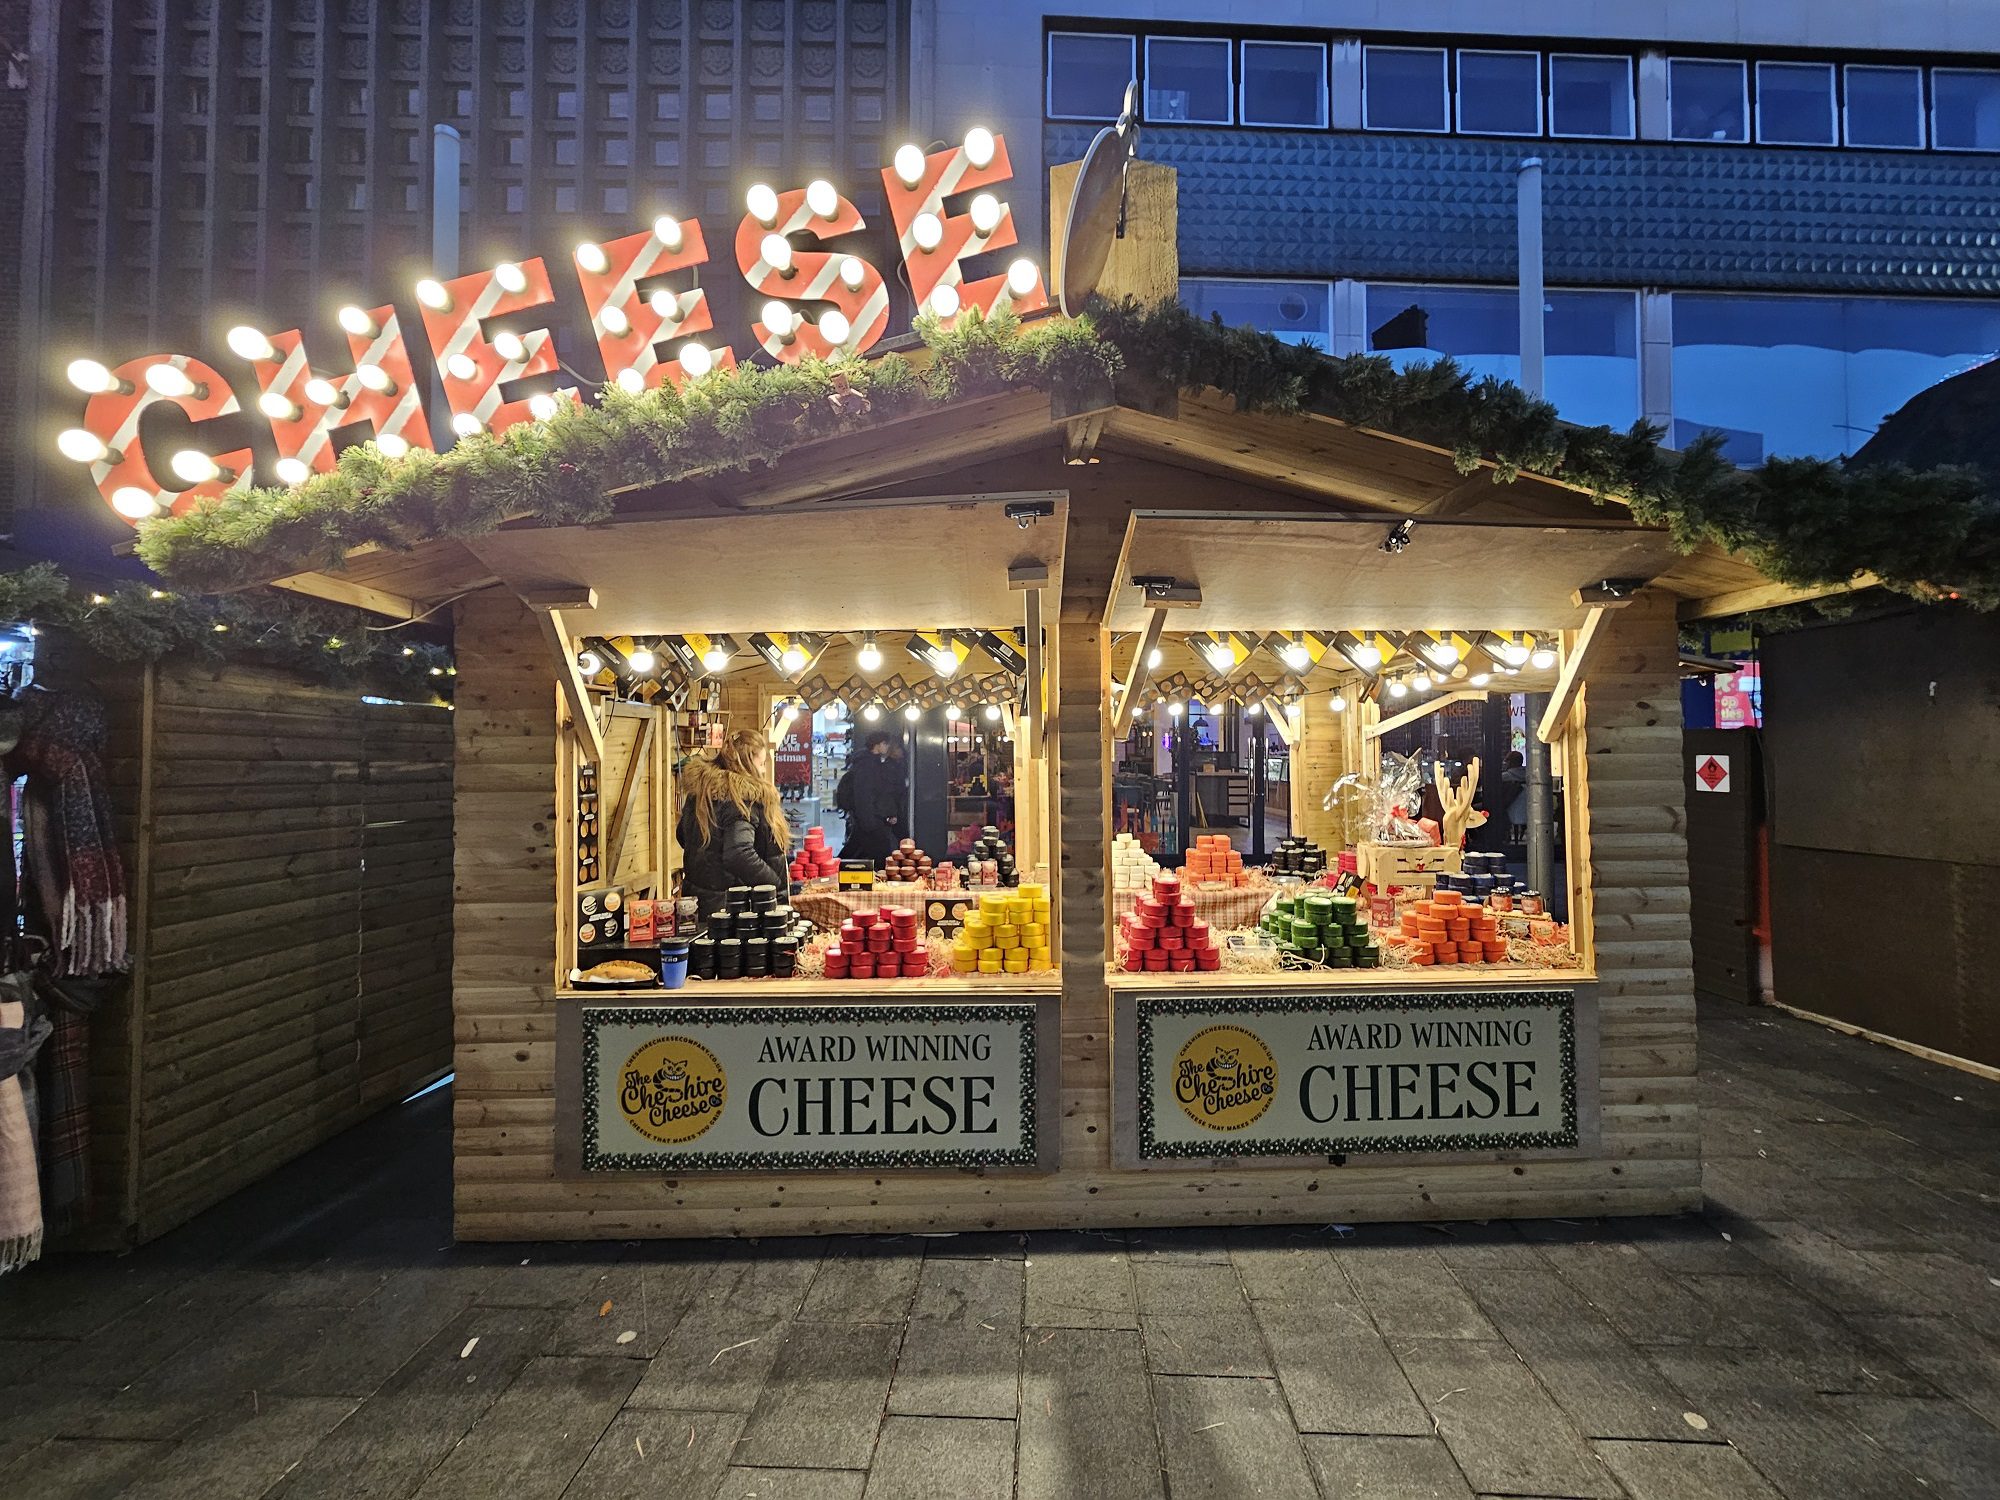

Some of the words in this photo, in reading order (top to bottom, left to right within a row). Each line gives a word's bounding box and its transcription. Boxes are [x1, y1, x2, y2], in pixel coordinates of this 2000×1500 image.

[82, 133, 1048, 527] CHEESE
[775, 752, 807, 762] istmas
[757, 1035, 856, 1063] AWARD
[865, 1033, 992, 1061] WINNING
[1180, 1024, 1274, 1062] CHESHIRECHEESECOMPANY.CO.UK
[1306, 1023, 1402, 1050] AWARD
[1410, 1020, 1533, 1048] WINNING
[626, 1035, 723, 1073] CHESHIRECHEESECOMPANY.CO.UK
[1179, 1059, 1205, 1077] The
[625, 1069, 652, 1089] The
[1299, 1060, 1540, 1124] CHEESE
[649, 1100, 711, 1127] Cheese
[748, 1075, 998, 1137] CHEESE
[1184, 1107, 1207, 1127] CHEESE
[1207, 1123, 1225, 1131] THAT
[1226, 1121, 1250, 1131] MAKES
[1250, 1112, 1263, 1124] YOU
[1261, 1096, 1274, 1113] GRIN
[1203, 1087, 1263, 1115] Cheese
[629, 1119, 652, 1139] CHEESE
[653, 1136, 671, 1144] THAT
[673, 1134, 697, 1144] MAKES
[697, 1125, 710, 1137] YOU
